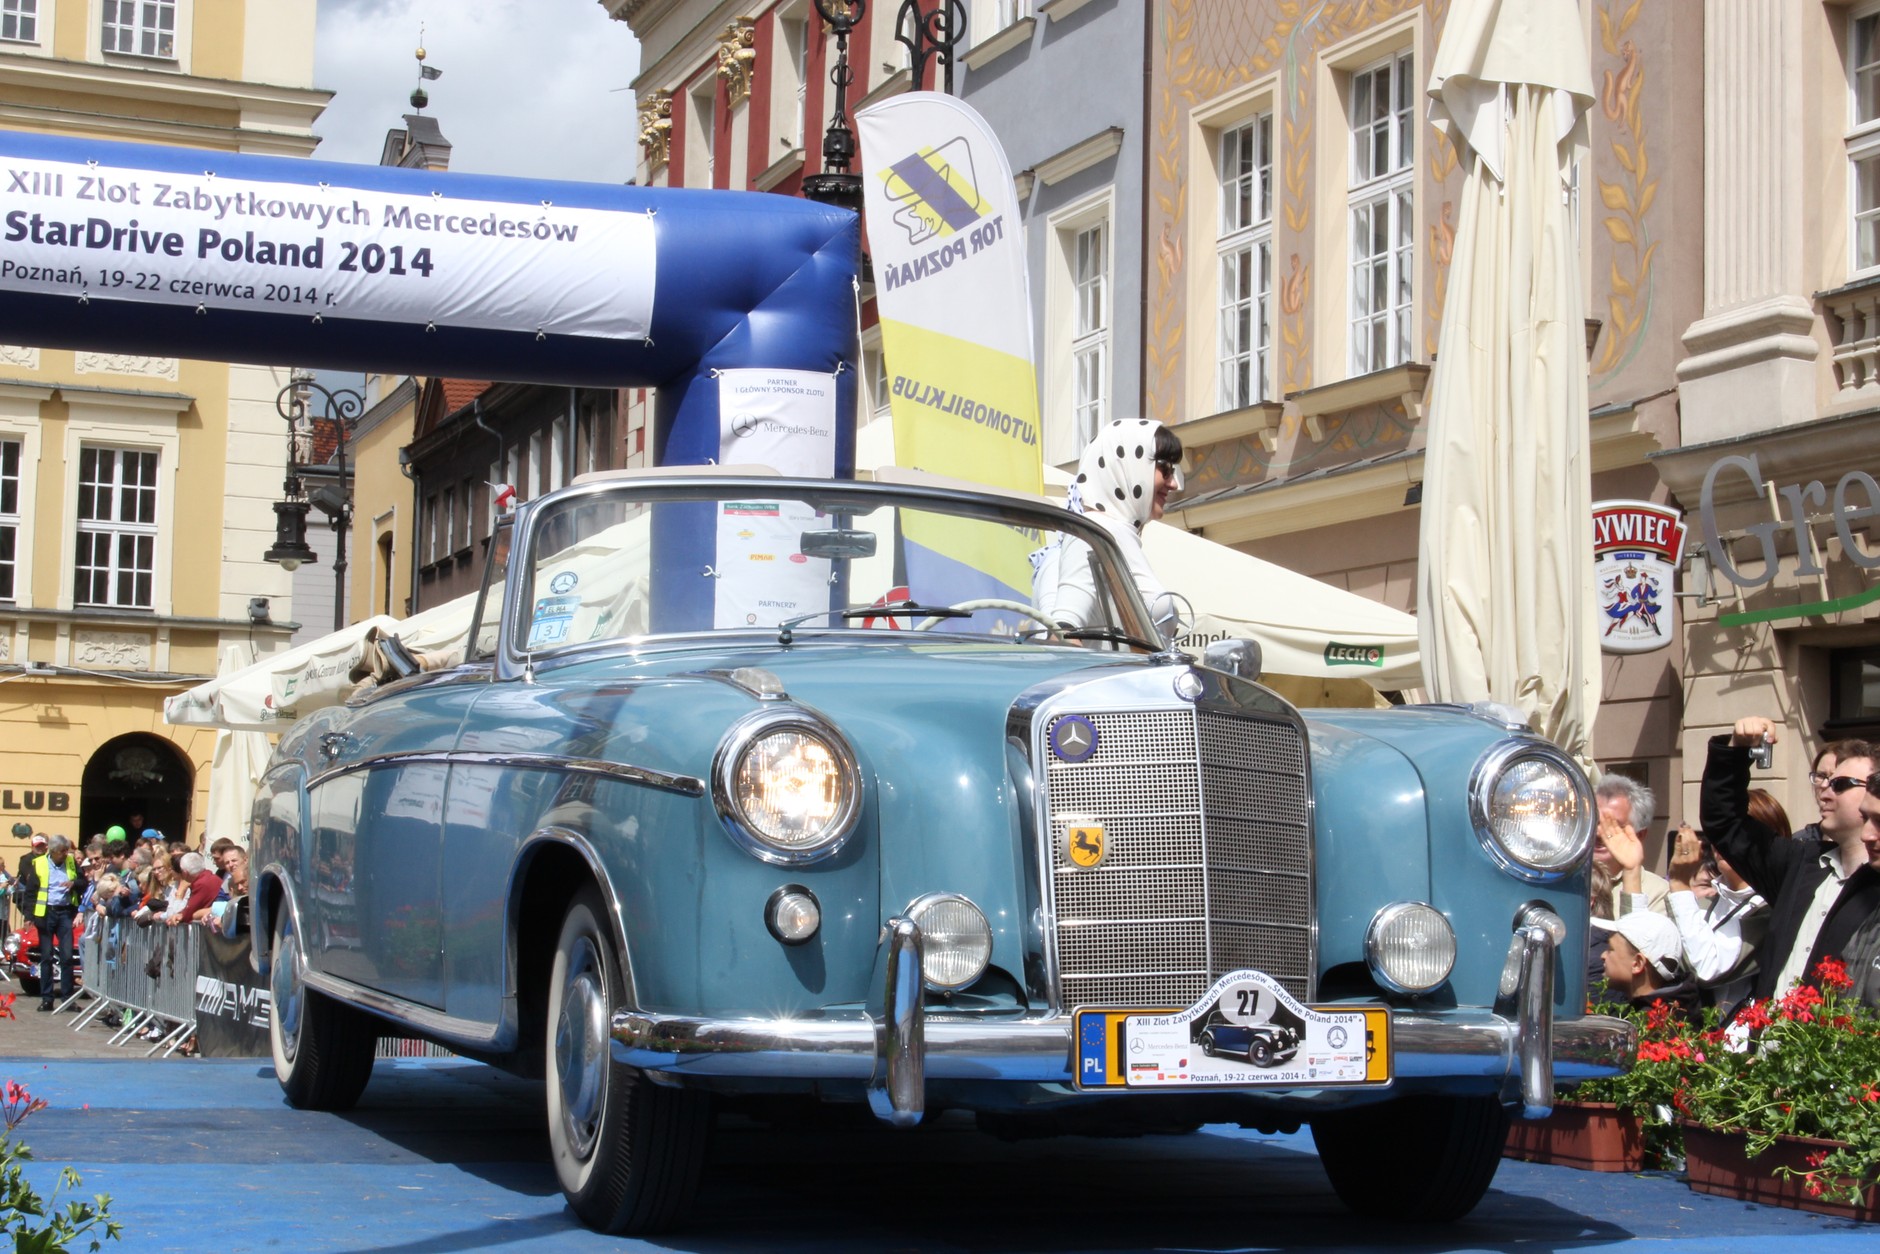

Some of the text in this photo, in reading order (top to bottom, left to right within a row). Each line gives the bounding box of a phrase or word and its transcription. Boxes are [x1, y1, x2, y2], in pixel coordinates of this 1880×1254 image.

[6, 169, 579, 243] XIII Zlot Zabytkowych Mercedesów
[5, 210, 434, 278] StarDrive Poland 2014
[1, 259, 339, 307] Poznań, 19-22 czerwca 2014 r.
[767, 378, 798, 387] PARTNER
[740, 386, 771, 394] GŁÓWNY
[773, 386, 804, 395] SPONSOR
[806, 388, 825, 397] ZLOTU
[763, 422, 829, 438] Mercedes-Benz
[758, 600, 797, 609] PARTNERZY
[1329, 647, 1366, 662] LECH
[0, 789, 70, 811] LUB
[1136, 1018, 1151, 1026] XIII
[1153, 1017, 1170, 1026] Zlot
[1173, 988, 1220, 1026] Zabytkowych
[1218, 971, 1268, 991] Mercedesów
[1304, 1011, 1331, 1024] Poland
[1236, 989, 1259, 1016] 27
[1084, 1057, 1103, 1073] PL
[1190, 1073, 1221, 1083] Poznań,
[1224, 1073, 1245, 1081] 19-22
[1247, 1073, 1278, 1081] czerwca
[1280, 1072, 1299, 1080] 2014
